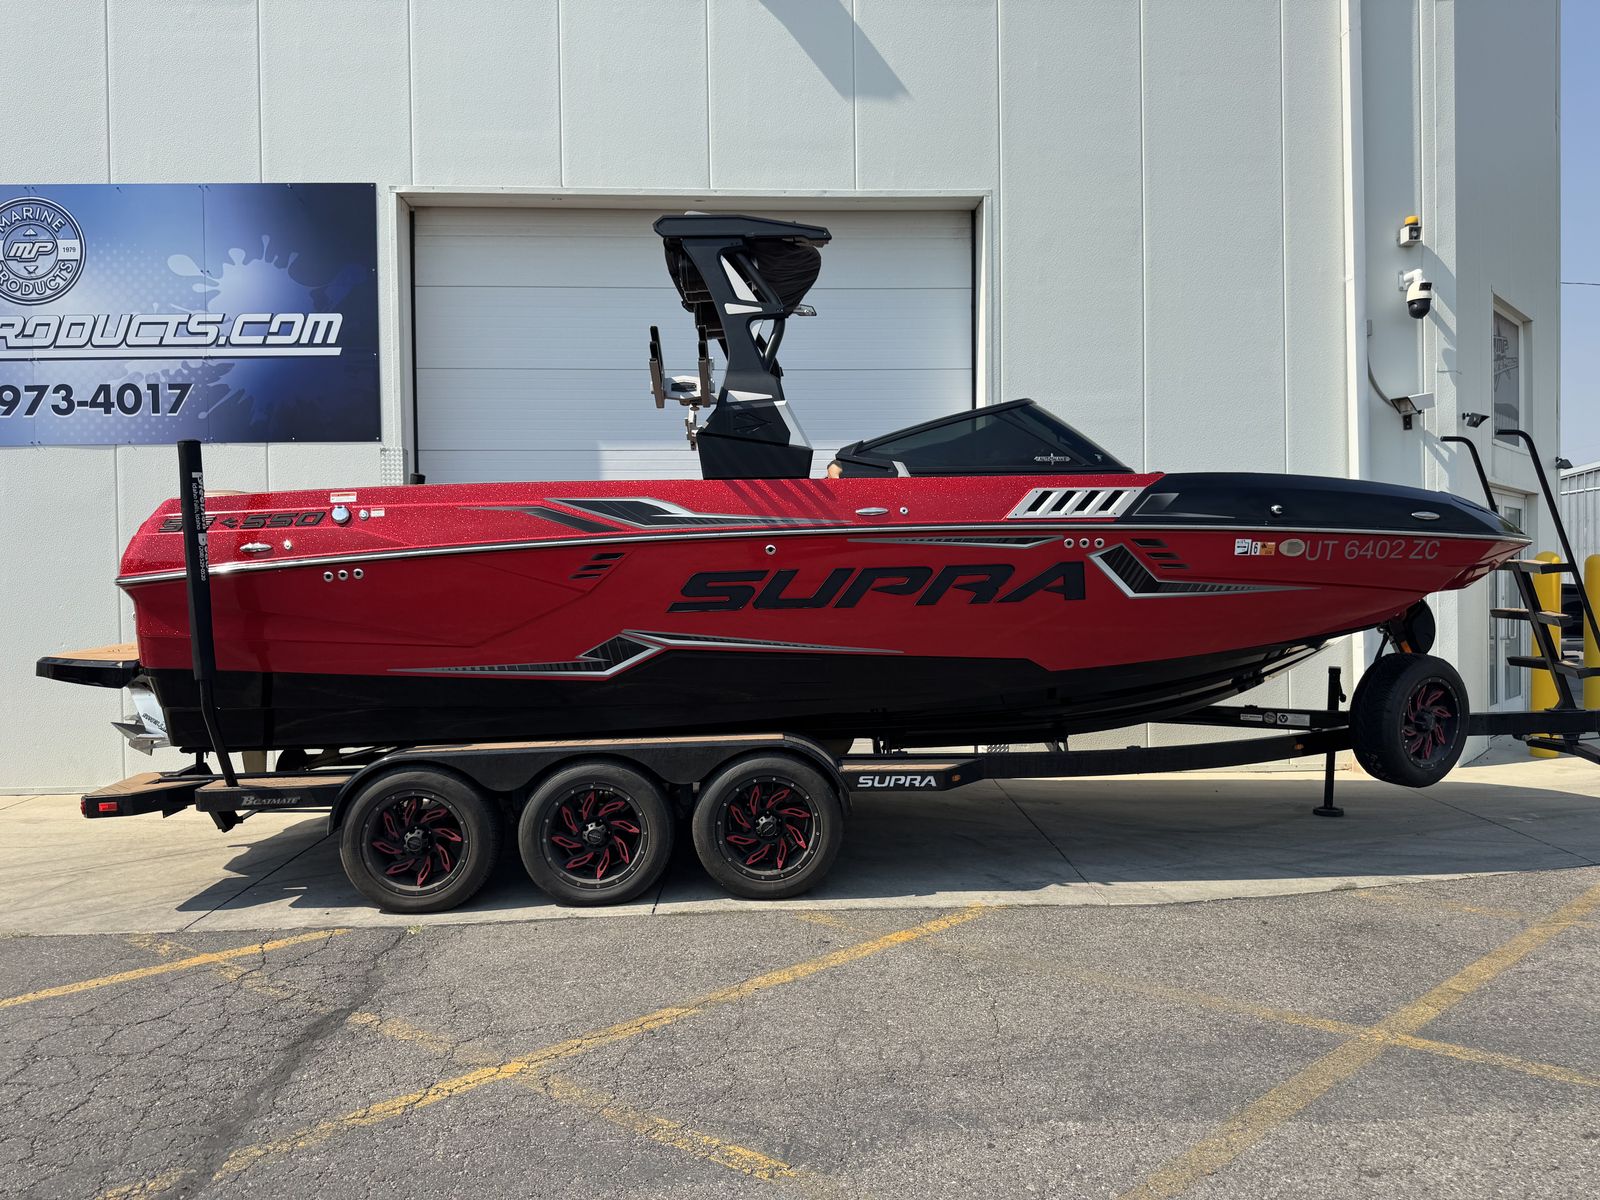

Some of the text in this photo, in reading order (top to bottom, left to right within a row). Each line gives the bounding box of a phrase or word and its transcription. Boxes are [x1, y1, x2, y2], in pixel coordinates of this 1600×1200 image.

[0, 207, 66, 233] MARINE
[0, 261, 74, 296] RODUCTS
[0, 383, 193, 417] 973-4017
[239, 511, 328, 531] 550
[1305, 538, 1441, 562] UT 6402 ZC
[666, 561, 1086, 614] SUPRA
[857, 775, 938, 789] SUPRA
